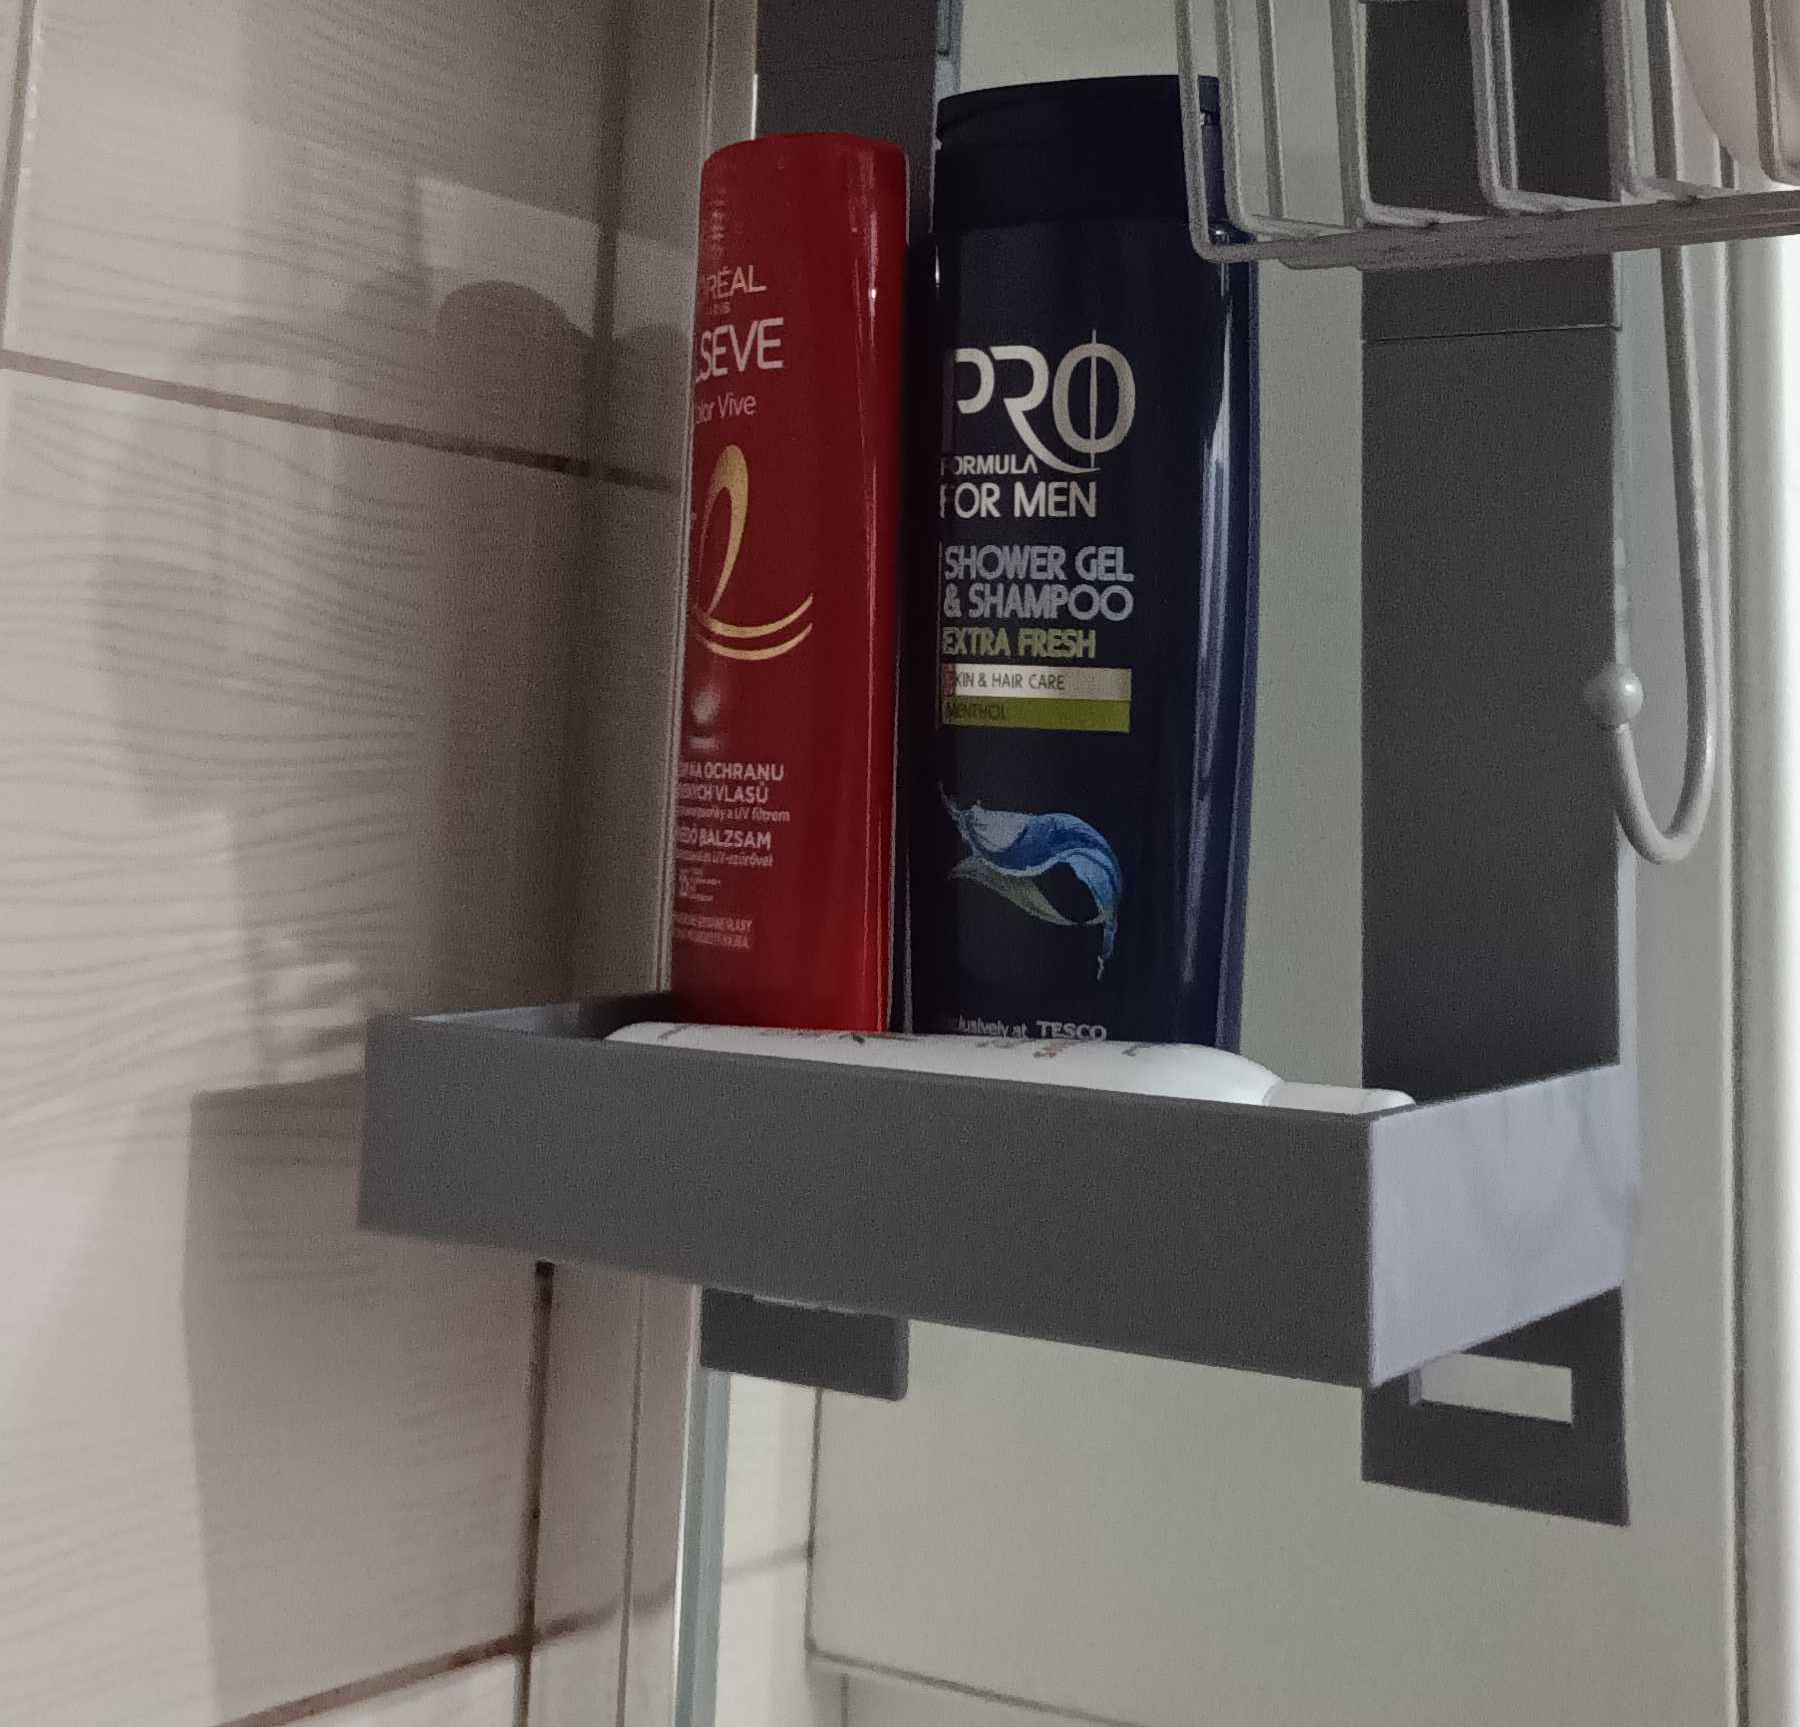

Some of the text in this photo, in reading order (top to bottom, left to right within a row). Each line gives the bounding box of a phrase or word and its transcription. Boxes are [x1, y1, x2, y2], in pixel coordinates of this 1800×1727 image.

[696, 317, 784, 383] SEVE
[717, 391, 757, 419] Vive
[955, 329, 1136, 473] PRO
[940, 481, 1097, 519] FOR MEN
[944, 544, 1135, 582] SHOWER GEL
[943, 583, 1134, 621] & SHAMPOO
[942, 626, 1096, 659] EXTRA FRESH
[979, 672, 987, 688] &
[992, 672, 1024, 690] HAIR
[1028, 674, 1065, 690] CARE
[704, 762, 784, 781] OCHRANU
[699, 828, 773, 850] BALZSAM
[1036, 1020, 1107, 1041] TESCO
